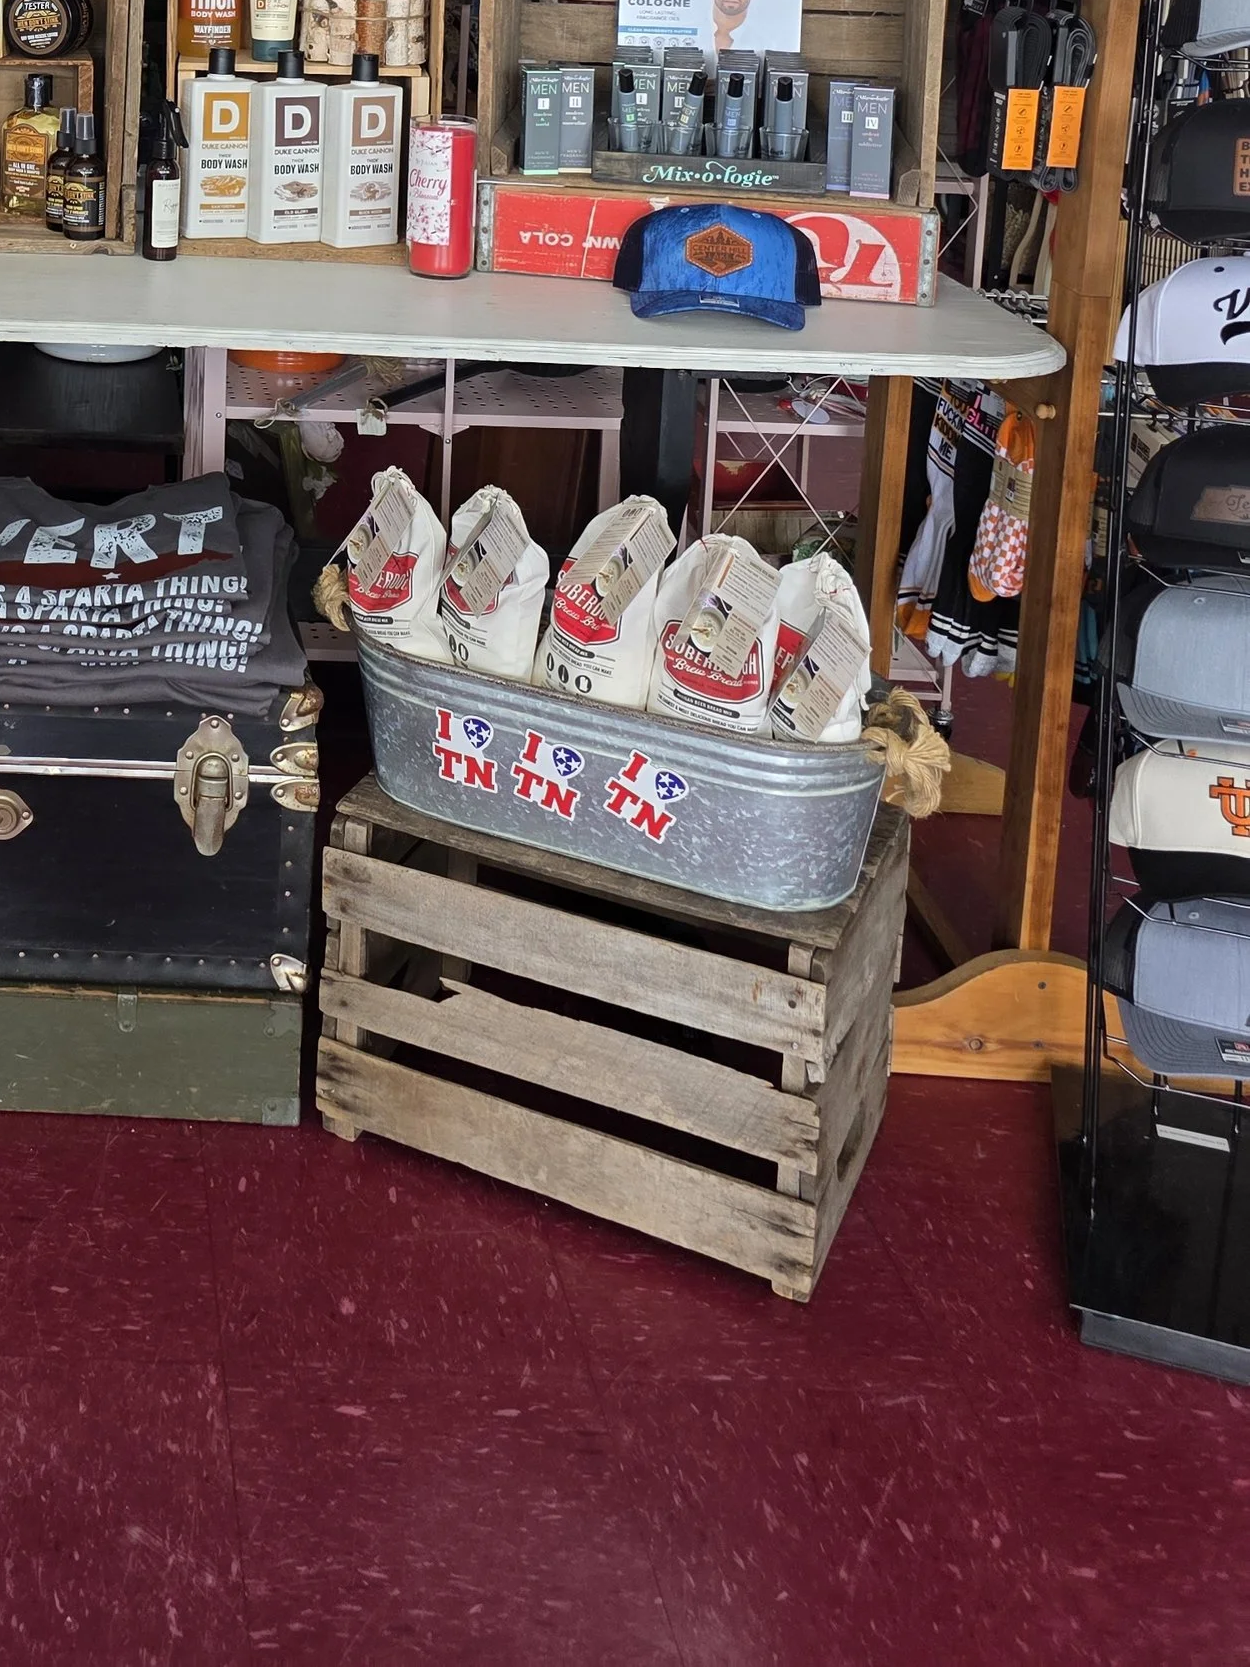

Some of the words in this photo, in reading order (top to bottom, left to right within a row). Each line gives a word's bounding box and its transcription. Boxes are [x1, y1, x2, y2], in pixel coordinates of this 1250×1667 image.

[24, 2, 49, 10] TESTER
[194, 25, 231, 34] WAYFINDER
[531, 84, 557, 94] MEN
[562, 83, 589, 93] MEN
[212, 100, 239, 133] D
[285, 105, 311, 138] D
[361, 105, 386, 138] D
[858, 103, 887, 114] MEN
[201, 159, 224, 169] BODY
[225, 159, 247, 169] WASH
[274, 165, 296, 175] BODY
[298, 164, 319, 174] WASH
[351, 165, 371, 175] BODY
[373, 164, 393, 174] WASH
[409, 169, 448, 197] Cherry
[519, 230, 573, 245] COLA
[15, 586, 31, 604] A
[42, 584, 144, 607] SPARTA
[154, 575, 248, 594] THING!
[17, 601, 121, 622] SPARTA
[165, 609, 263, 643] THING!
[674, 658, 706, 676] Brew
[708, 670, 743, 686] Bread
[438, 709, 451, 741] I
[523, 731, 543, 763] I
[434, 744, 495, 791] TN
[621, 752, 648, 783] I
[513, 764, 578, 818] TN
[607, 781, 673, 841] TN
